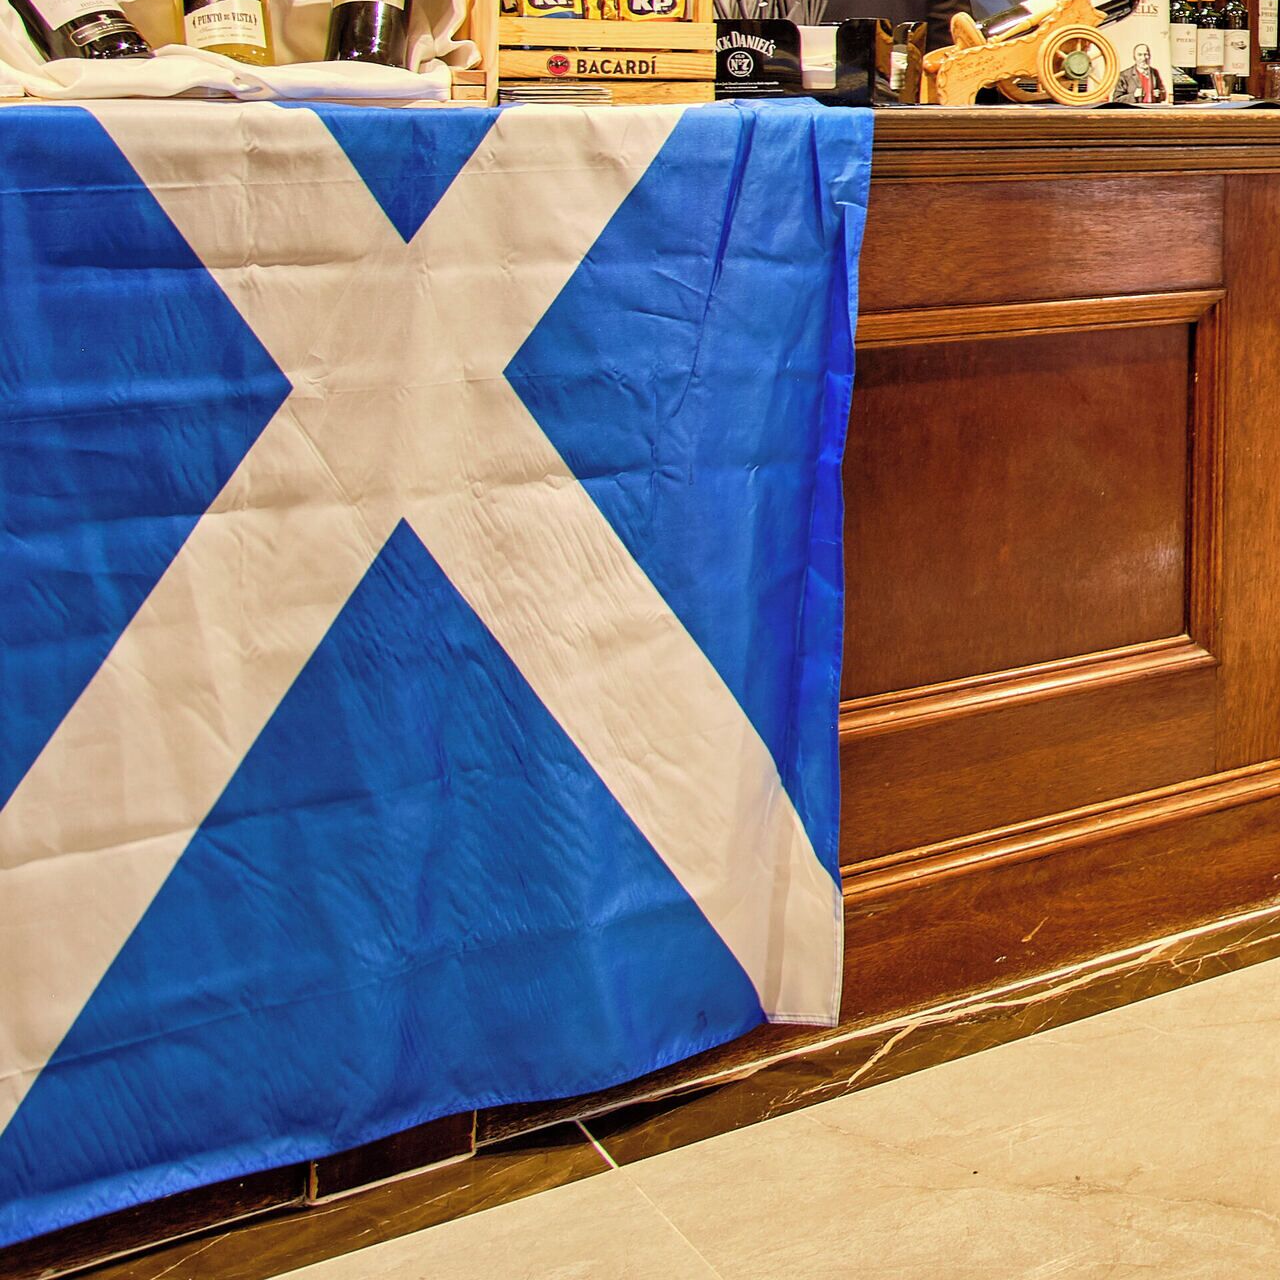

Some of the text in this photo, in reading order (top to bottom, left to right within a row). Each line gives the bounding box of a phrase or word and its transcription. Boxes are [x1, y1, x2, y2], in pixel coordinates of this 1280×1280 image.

[1134, 3, 1159, 14] ELL'S
[197, 12, 222, 26] PUNTO
[231, 11, 254, 24] VISTA
[730, 30, 777, 58] DANIEL'S
[576, 55, 657, 75] BACARDÍ
